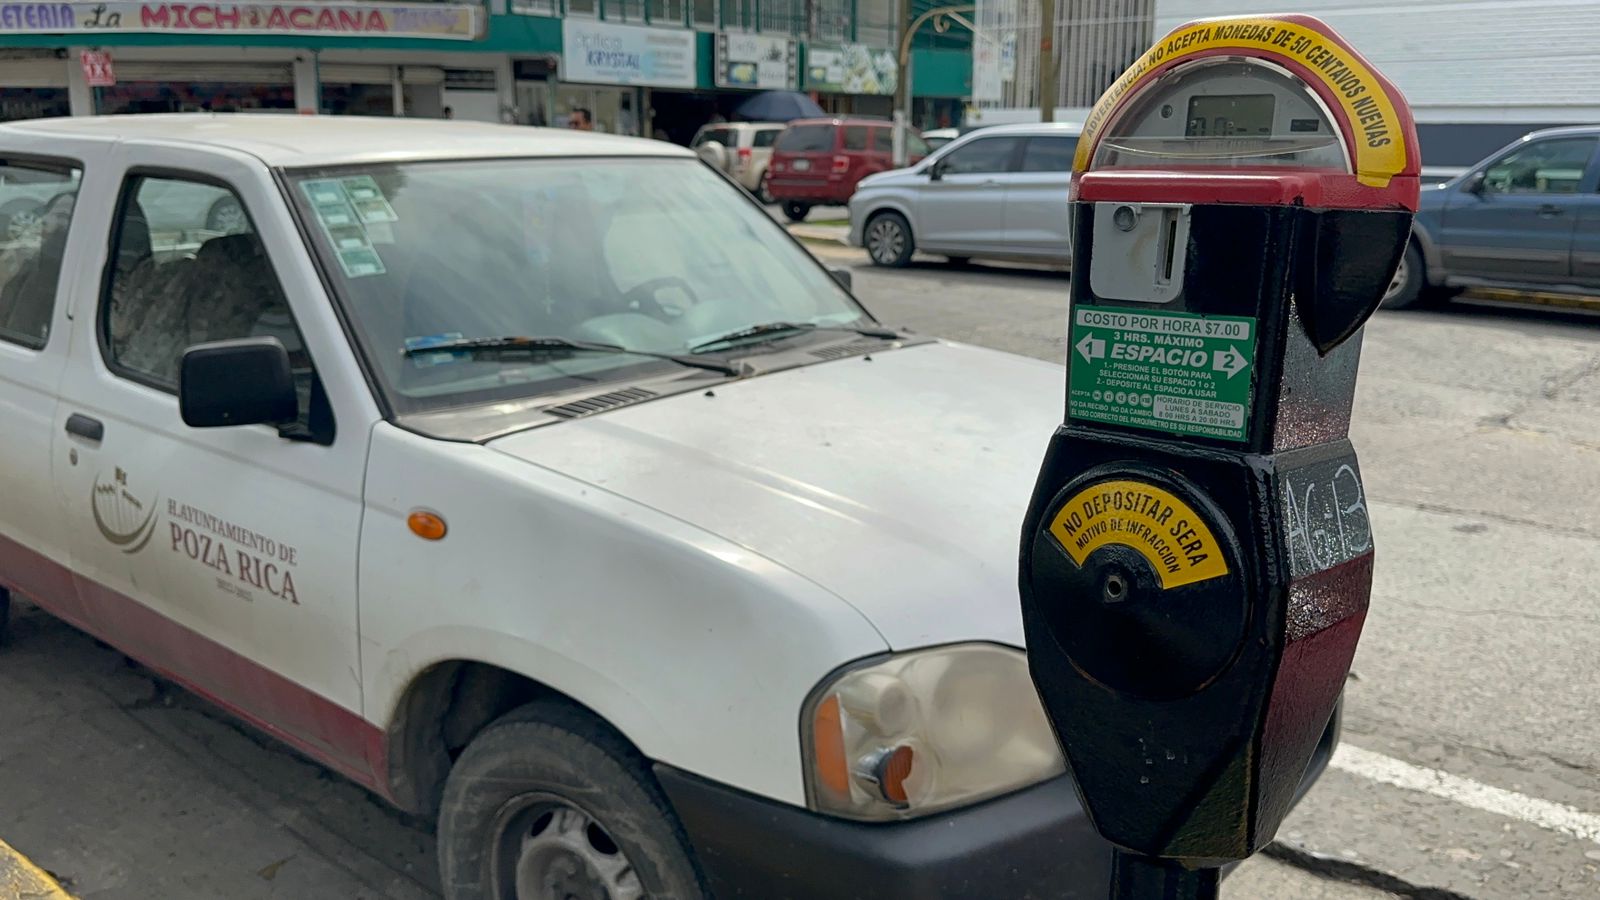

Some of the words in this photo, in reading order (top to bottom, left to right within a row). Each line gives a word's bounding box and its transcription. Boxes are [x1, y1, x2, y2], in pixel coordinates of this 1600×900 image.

[0, 3, 75, 29] ETERIA
[1086, 62, 1147, 138] ADVERTENCIA:
[1148, 47, 1164, 66] NO
[1166, 28, 1211, 56] ACEPTA
[1212, 24, 1275, 43] MONEDAS
[1272, 29, 1295, 48] DE
[1289, 35, 1312, 55] 50
[1305, 45, 1366, 99] CENTAVOS
[1351, 95, 1391, 149] NUEVAS
[1083, 312, 1128, 327] COSTO
[1131, 316, 1159, 330] POR
[1162, 319, 1201, 334] HORA
[1205, 321, 1240, 336] $7.00
[1113, 331, 1121, 341] 3
[1123, 332, 1151, 344] HRS.
[1153, 334, 1205, 348] MÁXIMO
[1085, 341, 1093, 355] 1
[1110, 342, 1208, 368] ESPACIO
[1222, 354, 1235, 369] 2
[1099, 369, 1150, 381] SELECCIONAR
[1151, 375, 1162, 383] SU
[1163, 377, 1197, 387] ESPACIO
[1113, 362, 1150, 374] PRESIONE
[1151, 367, 1160, 375] EL
[1190, 371, 1212, 380] PARA
[1106, 379, 1141, 390] DEPOSITE
[1154, 384, 1186, 395] ESPACIO
[1195, 390, 1217, 398] USAR
[1156, 396, 1191, 406] HORARIO
[1204, 401, 1241, 411] SERVICIO
[1164, 405, 1189, 413] LUNES
[1174, 413, 1190, 421] HRS
[1219, 419, 1236, 427] HRS
[1063, 511, 1083, 537] NO
[1083, 491, 1174, 526] DEPOSITAR
[1170, 519, 1209, 567] SERA
[279, 542, 297, 567] DE
[1075, 520, 1107, 551] MOTIVO
[1110, 518, 1123, 532] DE
[1126, 519, 1181, 574] INFRACCIÓN
[169, 520, 233, 576] POZA
[236, 549, 301, 605] RICA
